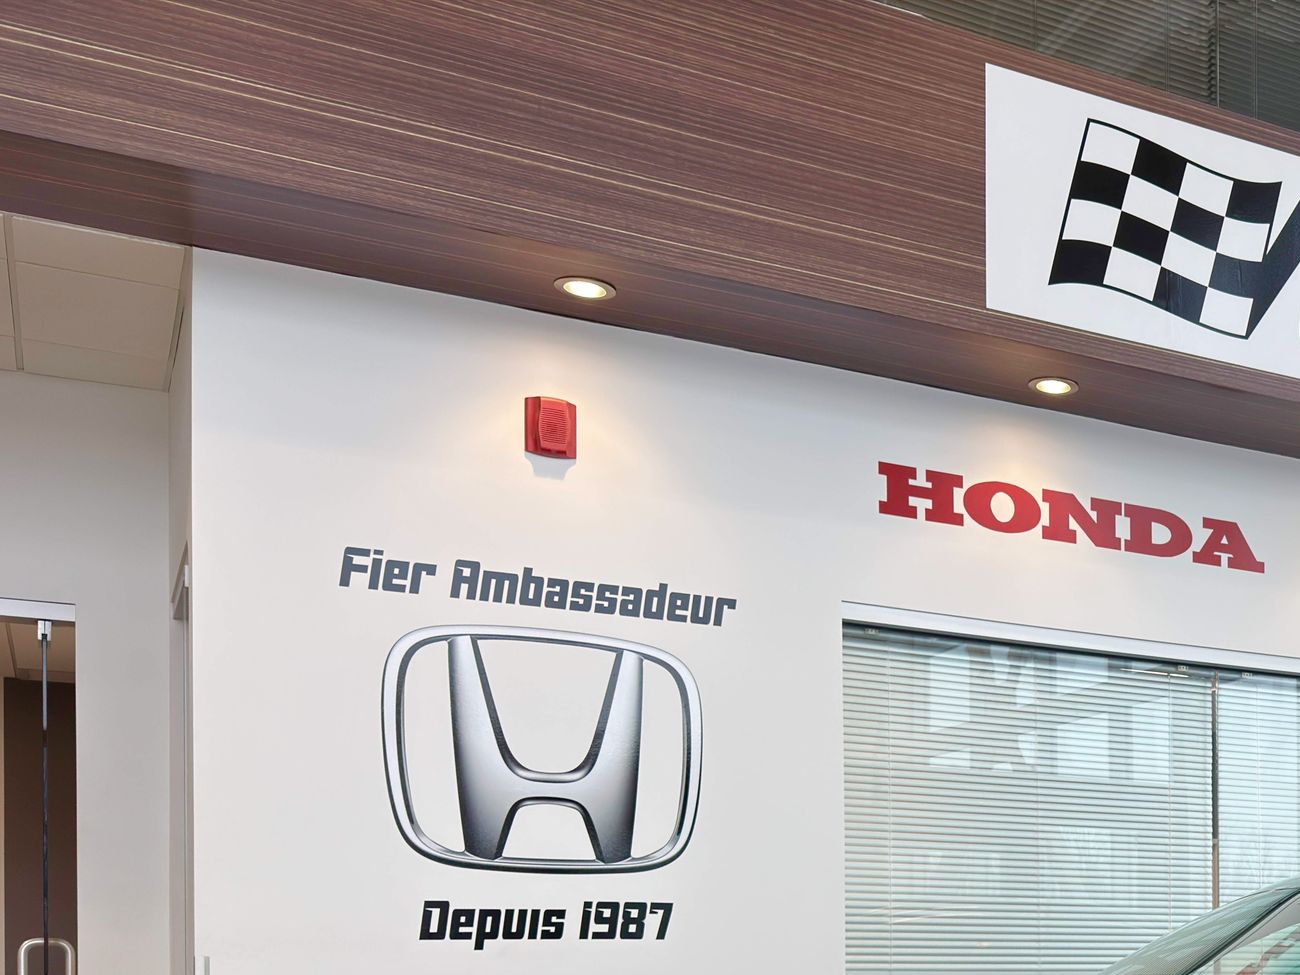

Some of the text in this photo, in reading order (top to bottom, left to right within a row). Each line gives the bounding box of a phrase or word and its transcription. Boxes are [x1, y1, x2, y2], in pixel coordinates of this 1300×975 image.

[878, 461, 1265, 573] HONDA
[338, 546, 737, 627] Fier Ambassadeur
[418, 900, 674, 951] Depuis 1987
